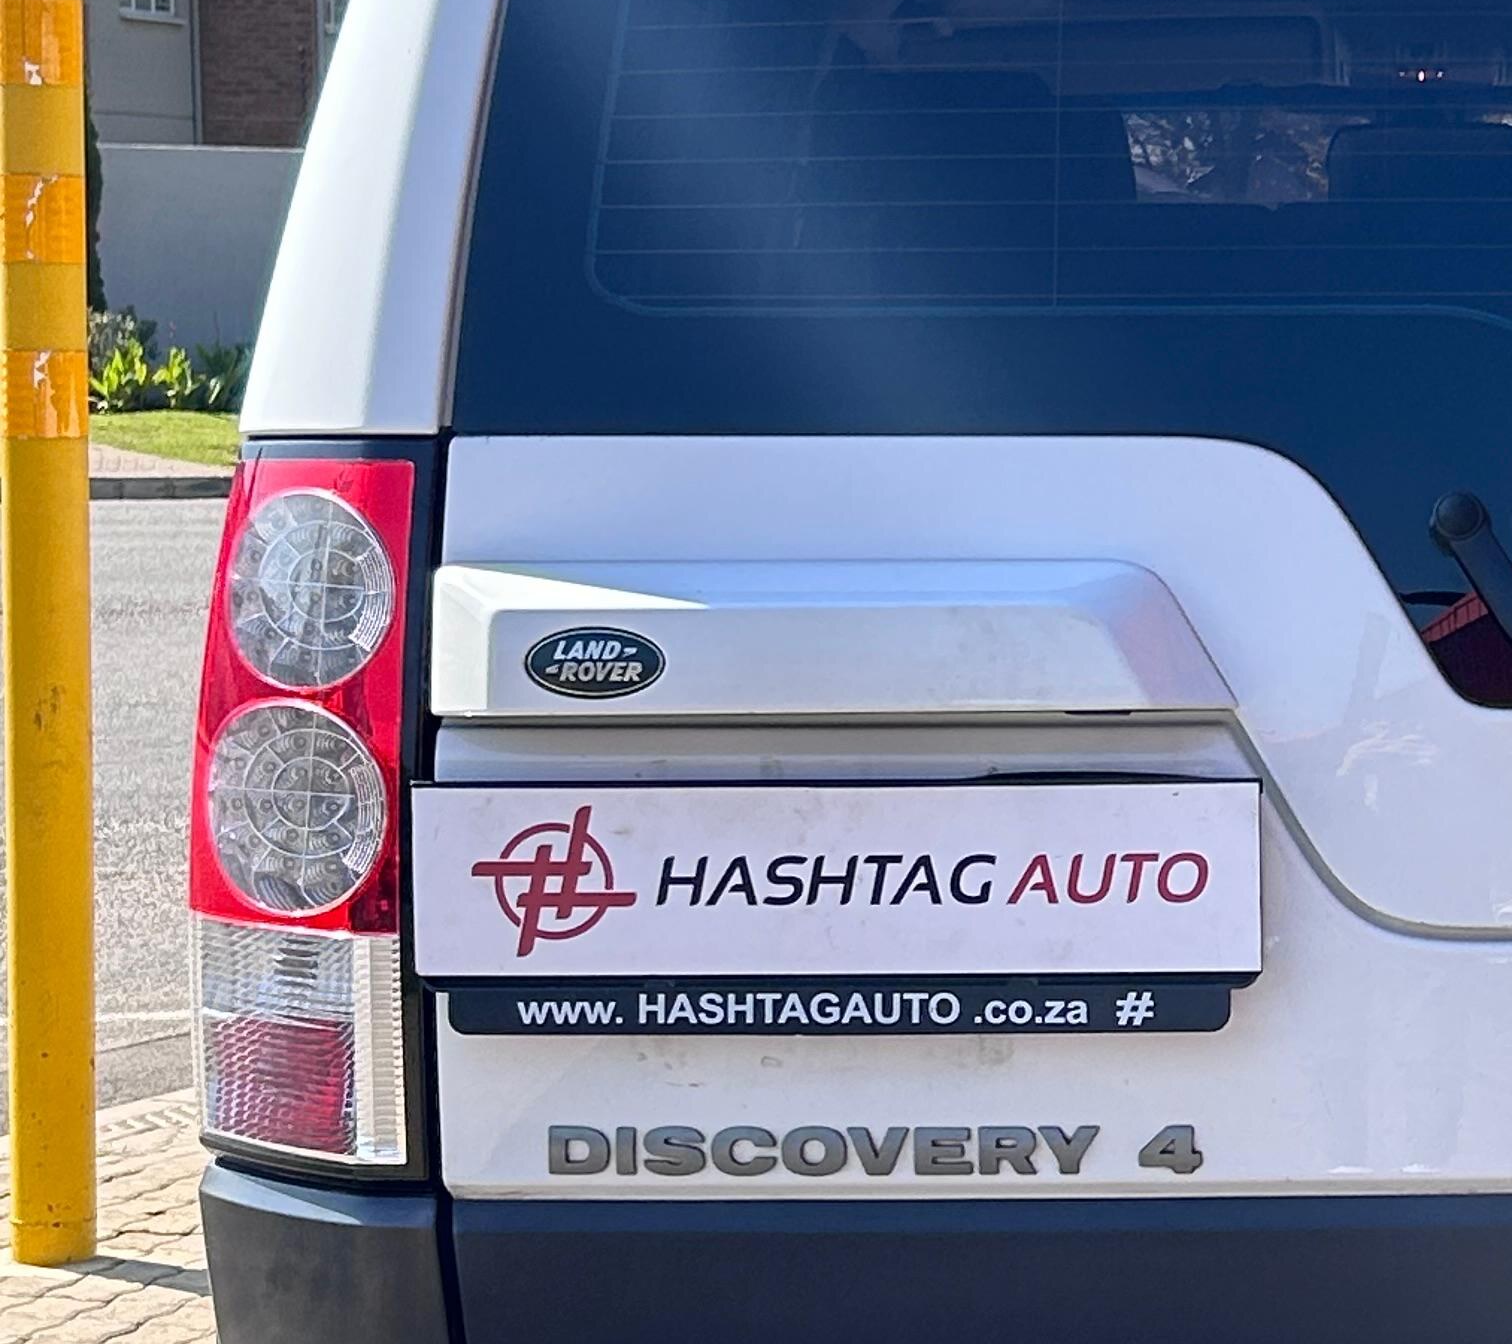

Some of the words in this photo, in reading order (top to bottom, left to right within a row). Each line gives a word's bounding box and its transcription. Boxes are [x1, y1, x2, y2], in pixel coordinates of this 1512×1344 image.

[553, 640, 632, 660] LAND
[559, 661, 643, 682] ROVER
[656, 855, 997, 906] HASHTAG
[1006, 852, 1210, 905] AUTO
[637, 992, 962, 1026] HASHTAGAUTO
[548, 1125, 1101, 1177] DISCOVERY
[1138, 1124, 1205, 1174] 4
